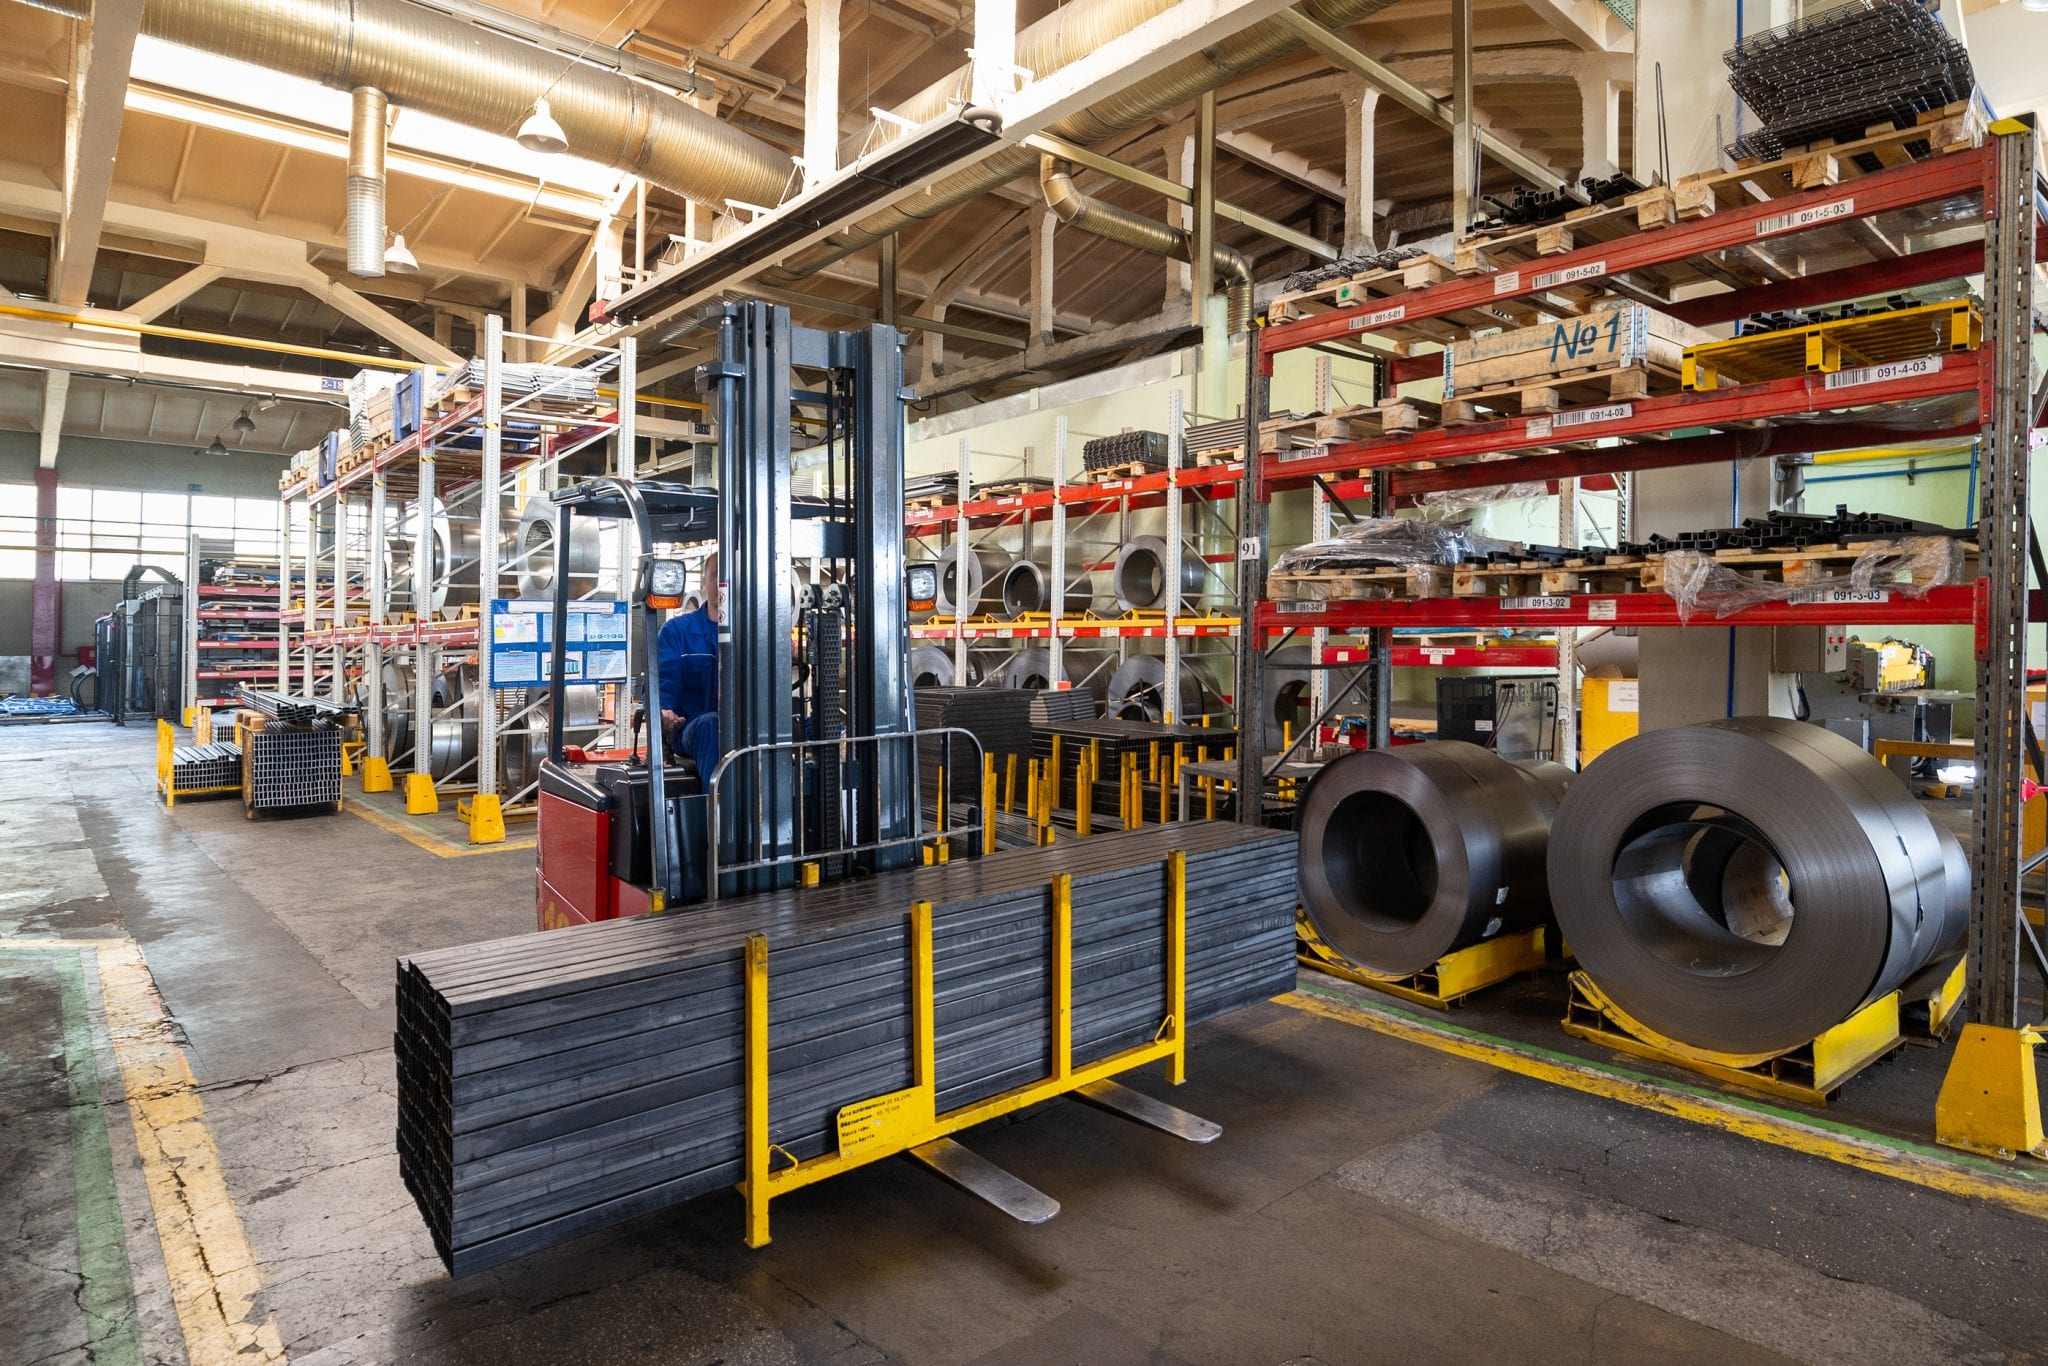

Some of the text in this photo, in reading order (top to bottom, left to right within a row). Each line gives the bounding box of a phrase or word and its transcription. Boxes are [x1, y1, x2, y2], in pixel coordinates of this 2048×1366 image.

[1800, 203, 1846, 222] 091-5-03
[1566, 264, 1601, 280] 091-5-02
[1374, 310, 1401, 322] 091-5-01
[1877, 360, 1927, 378] 091-4-03
[322, 379, 344, 390] 2-18
[1590, 407, 1624, 420] 091-4-02
[1242, 542, 1256, 556] 91
[1532, 598, 1565, 607] 091-3-02
